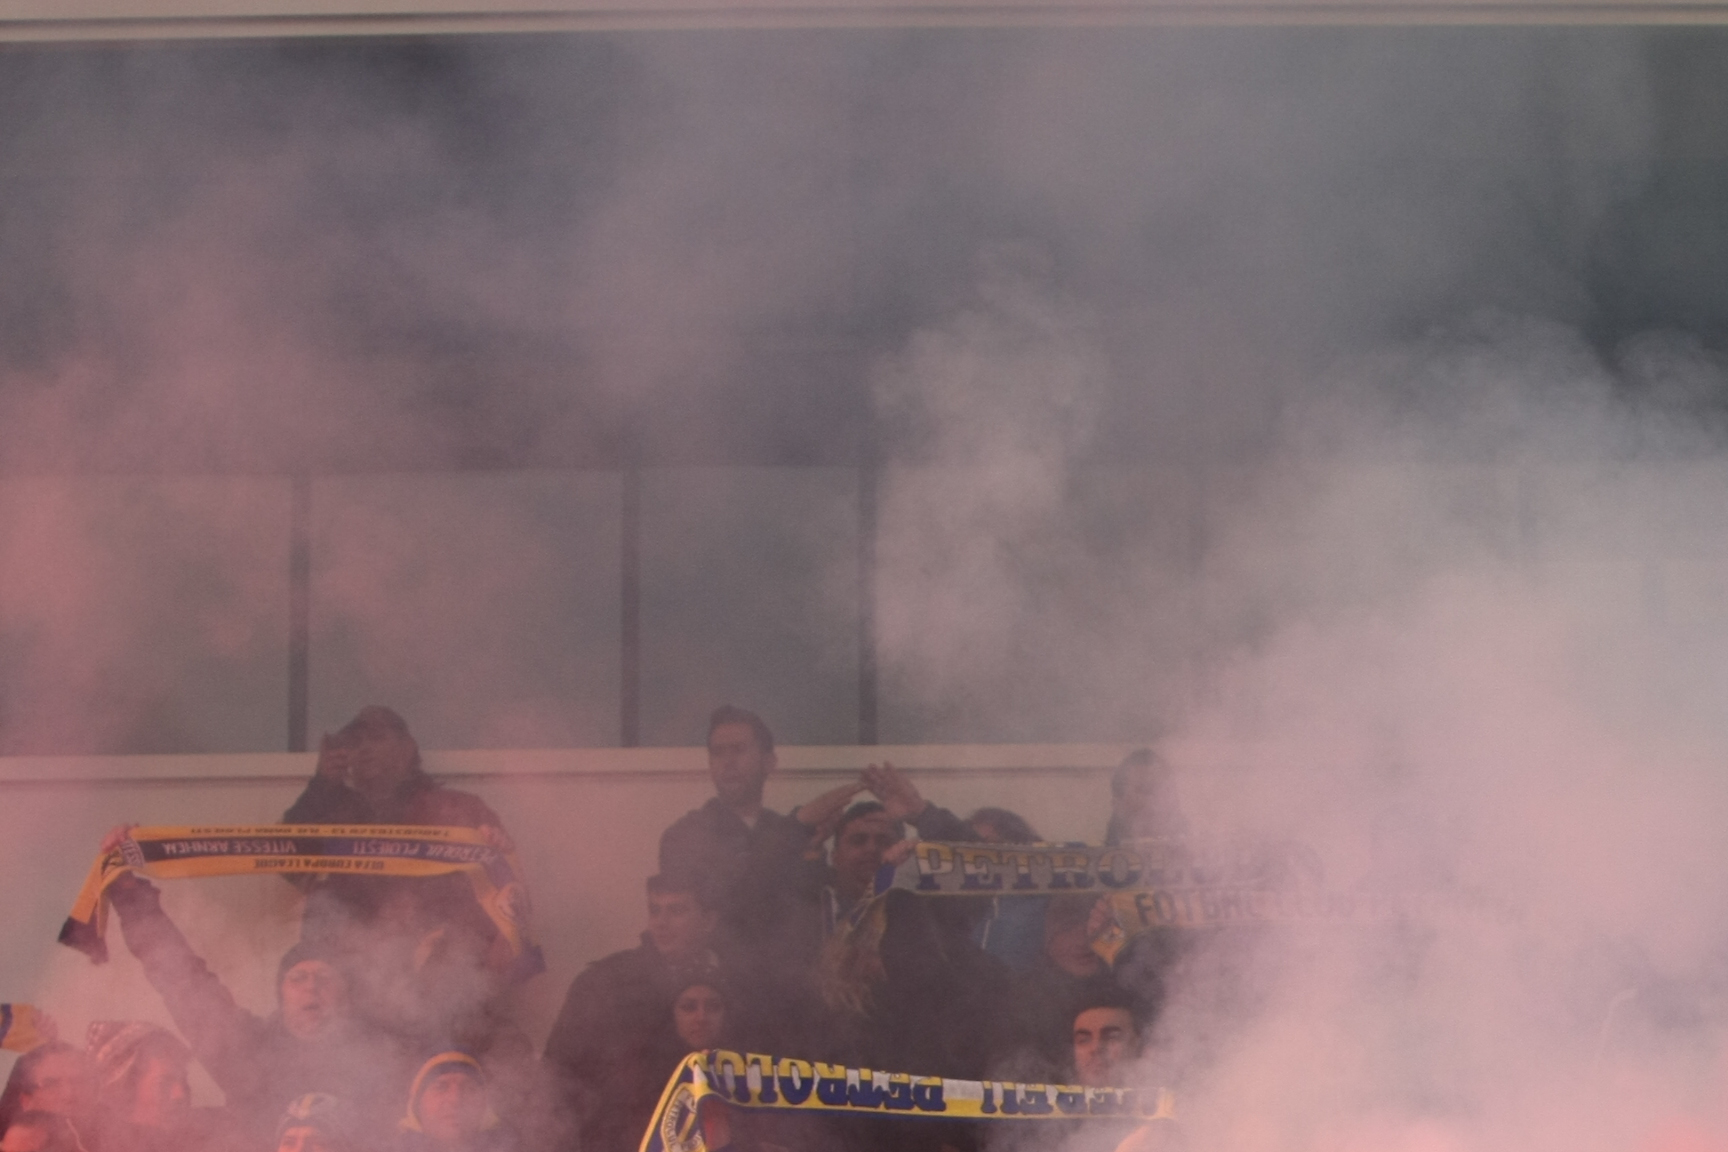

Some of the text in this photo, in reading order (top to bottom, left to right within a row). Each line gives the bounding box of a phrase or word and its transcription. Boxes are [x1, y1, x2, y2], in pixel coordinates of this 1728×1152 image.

[163, 840, 229, 858] ARNHEM
[234, 839, 298, 856] VITESSE
[253, 857, 301, 870] LEAGUE
[302, 858, 353, 871] EUROPA
